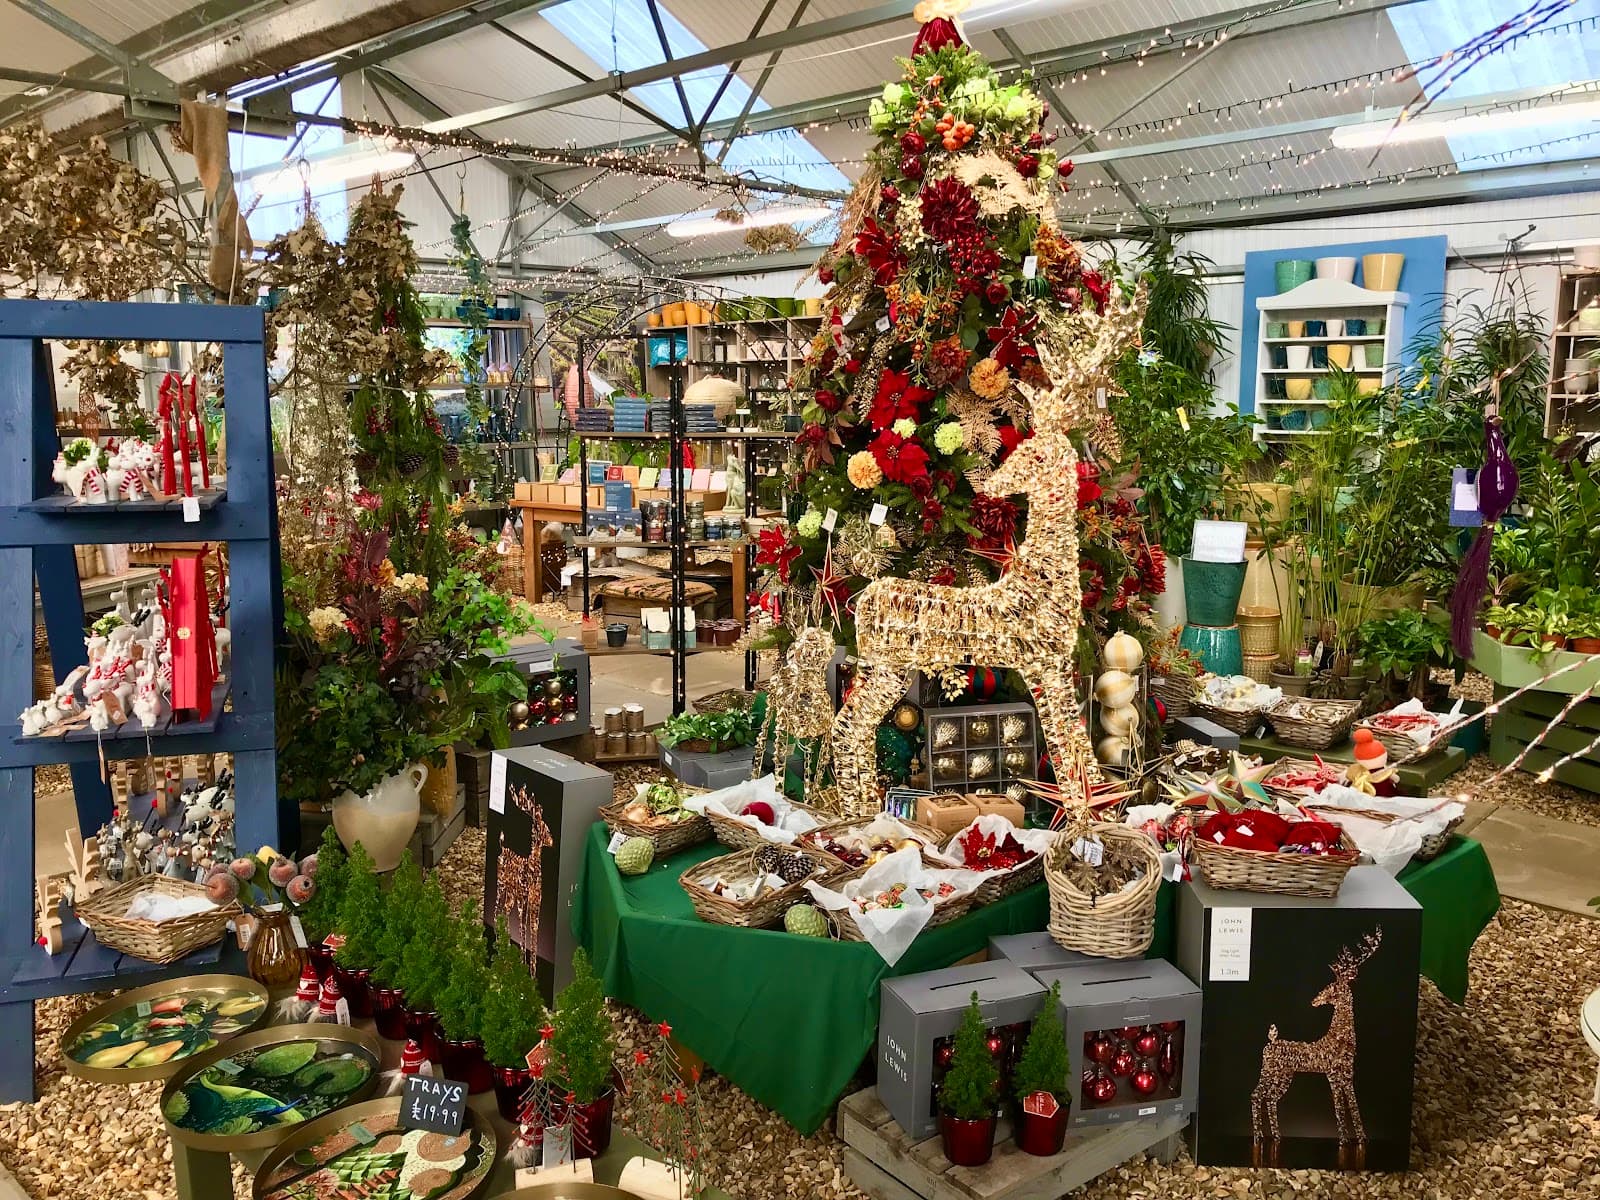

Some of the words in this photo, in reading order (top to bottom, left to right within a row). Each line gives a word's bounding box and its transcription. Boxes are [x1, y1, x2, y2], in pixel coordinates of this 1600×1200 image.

[887, 1034, 907, 1062] JOHN
[884, 1051, 907, 1082] LEWIS
[408, 1077, 463, 1106] TRAYS
[411, 1096, 458, 1126] £19.99
